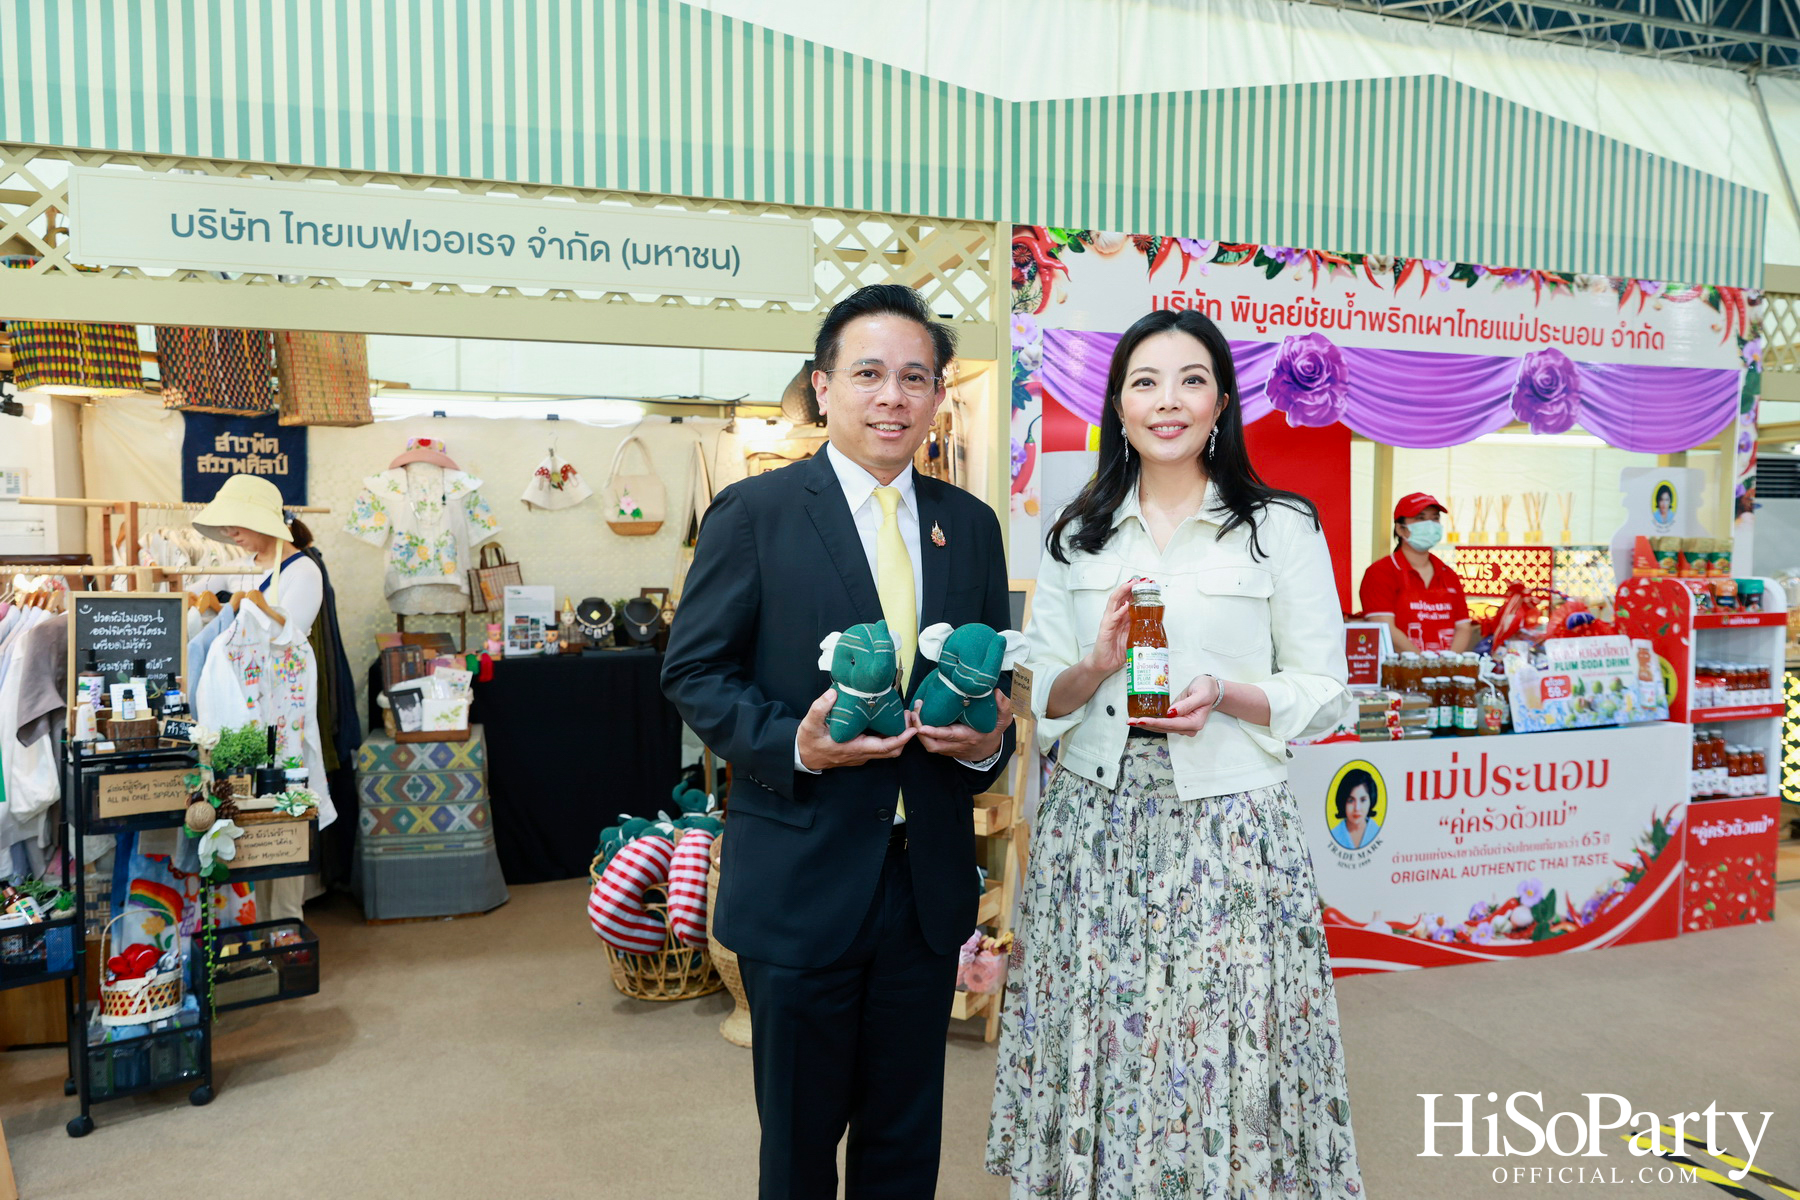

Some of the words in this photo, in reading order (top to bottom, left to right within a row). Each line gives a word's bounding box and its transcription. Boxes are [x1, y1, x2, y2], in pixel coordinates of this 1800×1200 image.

[171, 207, 271, 243] บริษัท
[279, 210, 516, 258] ไทยเบฟเวอเรจ
[527, 225, 611, 263] จำกัด
[621, 237, 741, 277] (มหาชน)
[1230, 292, 1605, 347] พิบูลย์ชัยน้ำพริกเผาไทยแม่ประนอม
[1612, 320, 1665, 351] จำกัด
[214, 431, 279, 454] สารพัด
[1554, 660, 1579, 671] PLUM
[1581, 659, 1604, 670] SODA
[1606, 657, 1632, 668] DRINK
[1404, 751, 1610, 802] แม่ประนอม
[153, 790, 181, 800] SPRAY
[1327, 841, 1355, 861] TRADE
[1357, 839, 1384, 859] MARK
[1581, 831, 1602, 847] 65
[1391, 867, 1458, 884] ORIGINAL
[1460, 859, 1537, 878] AUTHENTIC
[1540, 855, 1569, 869] THAI
[1572, 852, 1610, 867] TASTE
